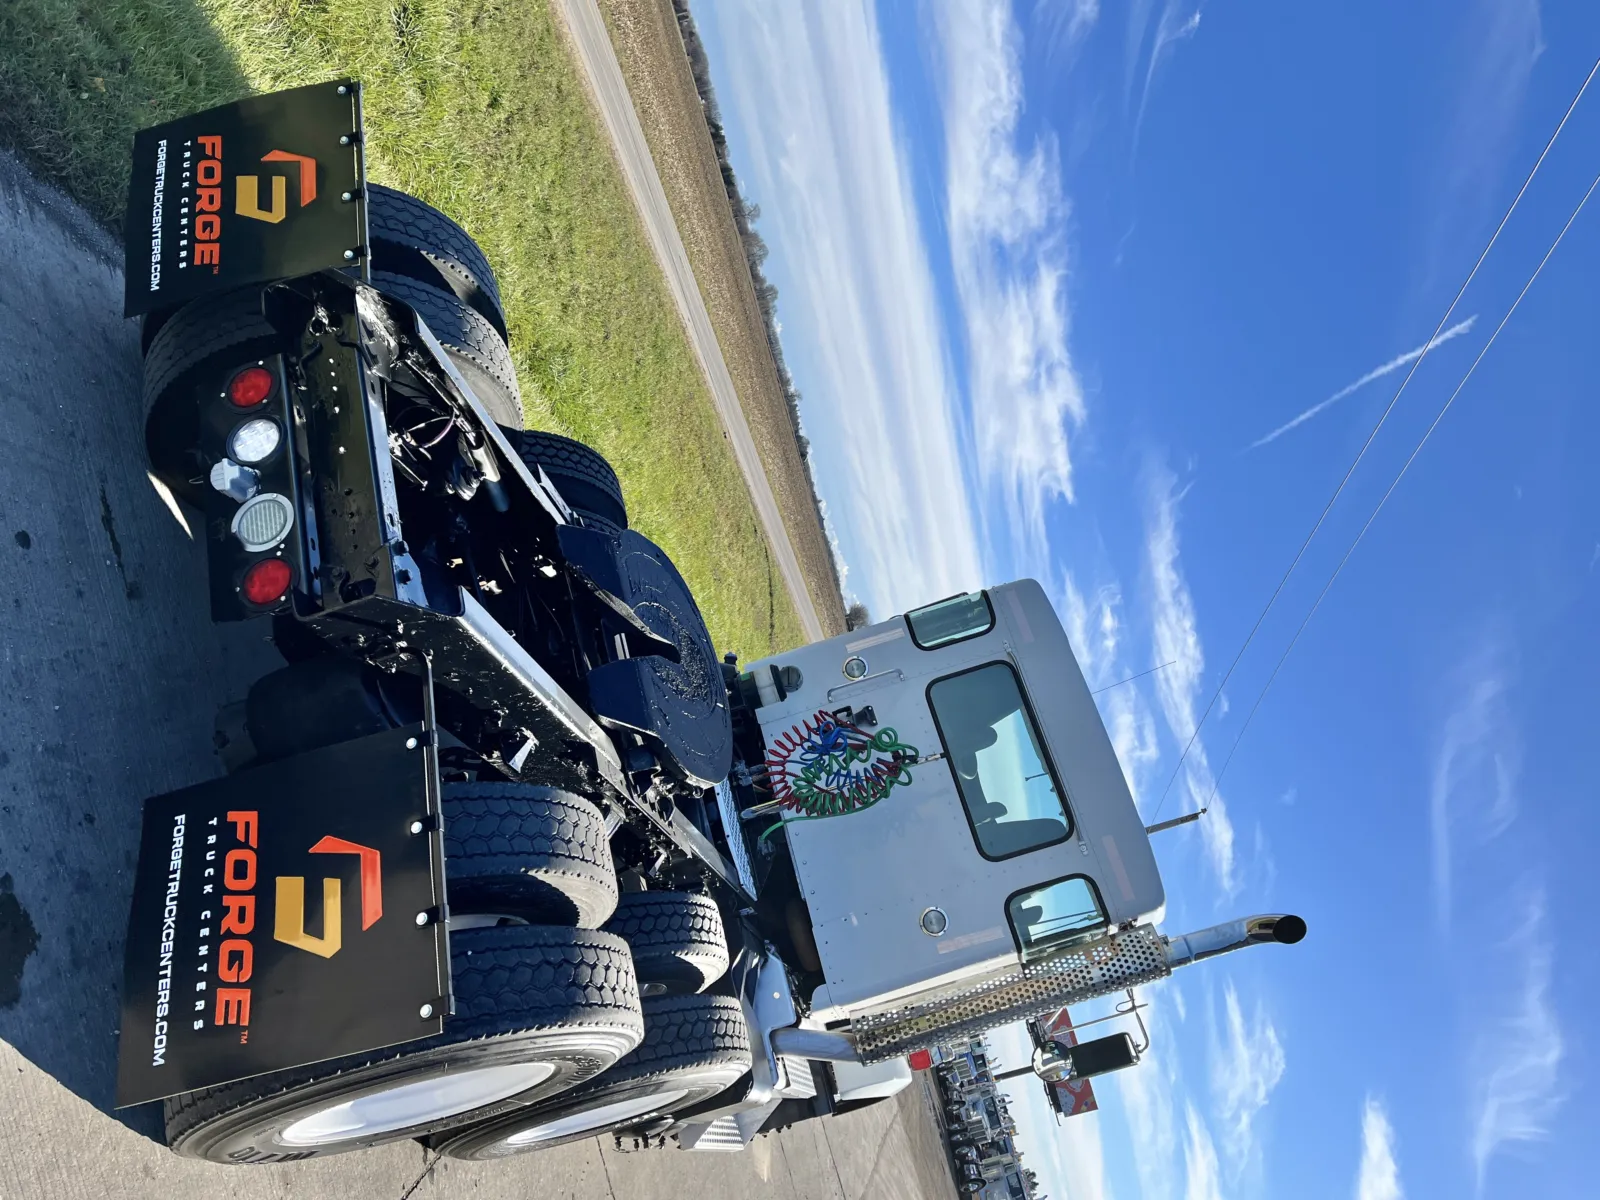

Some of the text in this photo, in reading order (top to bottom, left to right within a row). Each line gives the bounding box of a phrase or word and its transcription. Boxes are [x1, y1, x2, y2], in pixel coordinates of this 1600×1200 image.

[150, 139, 167, 292] FORGETRUCKCENTERS.COM
[179, 140, 192, 269] TRUCK CENTERS
[194, 135, 222, 266] FORGE
[151, 813, 186, 1068] FORGETRUCKCENTERS.COM
[193, 816, 218, 1032] TRUCK CENTERS
[214, 811, 259, 1027] FORGE
